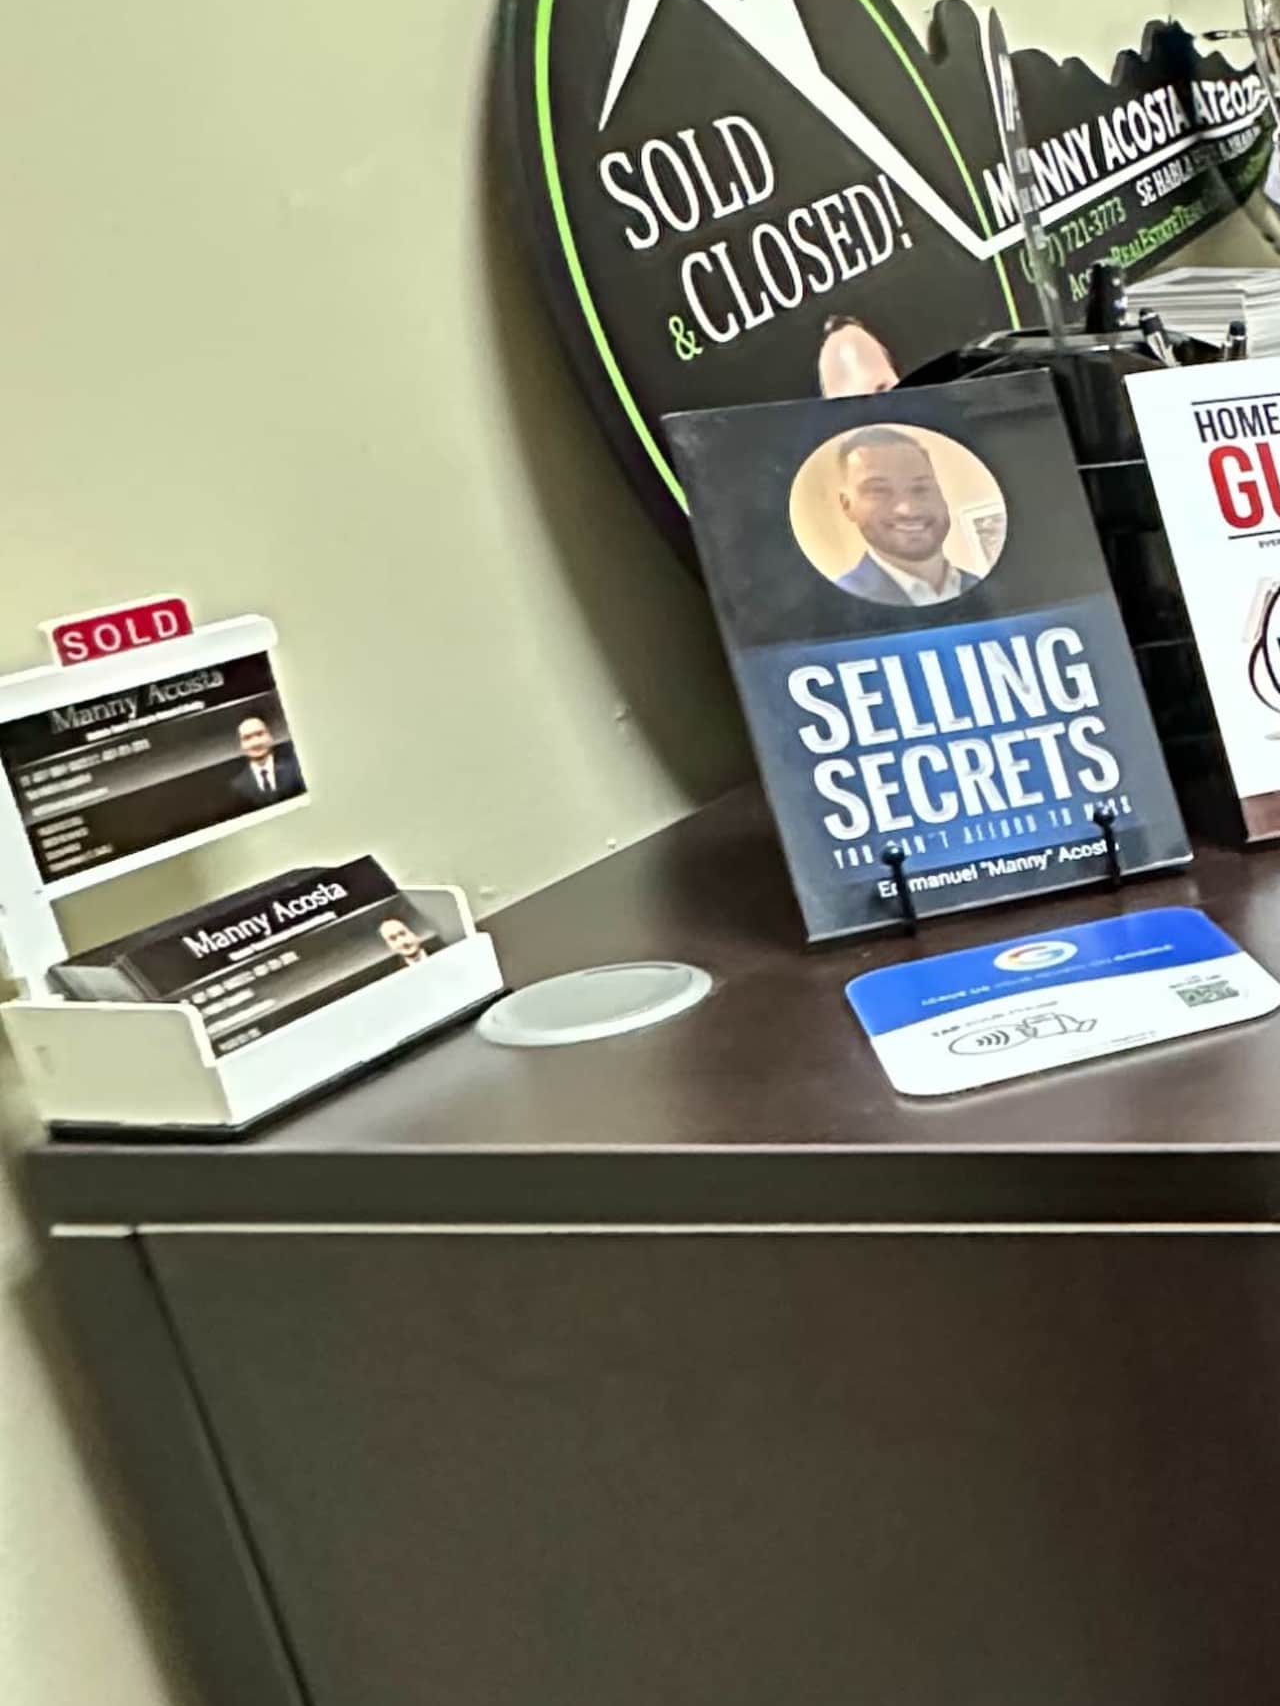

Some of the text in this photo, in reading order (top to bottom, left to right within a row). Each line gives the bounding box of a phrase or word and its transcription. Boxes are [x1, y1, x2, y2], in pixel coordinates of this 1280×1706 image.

[1098, 84, 1192, 171] ACOSTA
[600, 115, 775, 250] SOLD
[1136, 176, 1157, 207] SE
[1060, 196, 1126, 253] 721-3773
[668, 174, 914, 360] & CLOSED!
[62, 609, 179, 661] SOLD
[51, 695, 139, 734] Manny
[148, 670, 225, 705] Acosta
[787, 626, 1100, 755] SELLING
[812, 716, 1121, 841] SECRETS
[979, 849, 1054, 877] "Manny"
[1058, 839, 1120, 863] Acost
[182, 913, 273, 959] Manny
[272, 882, 349, 923] Acosta
